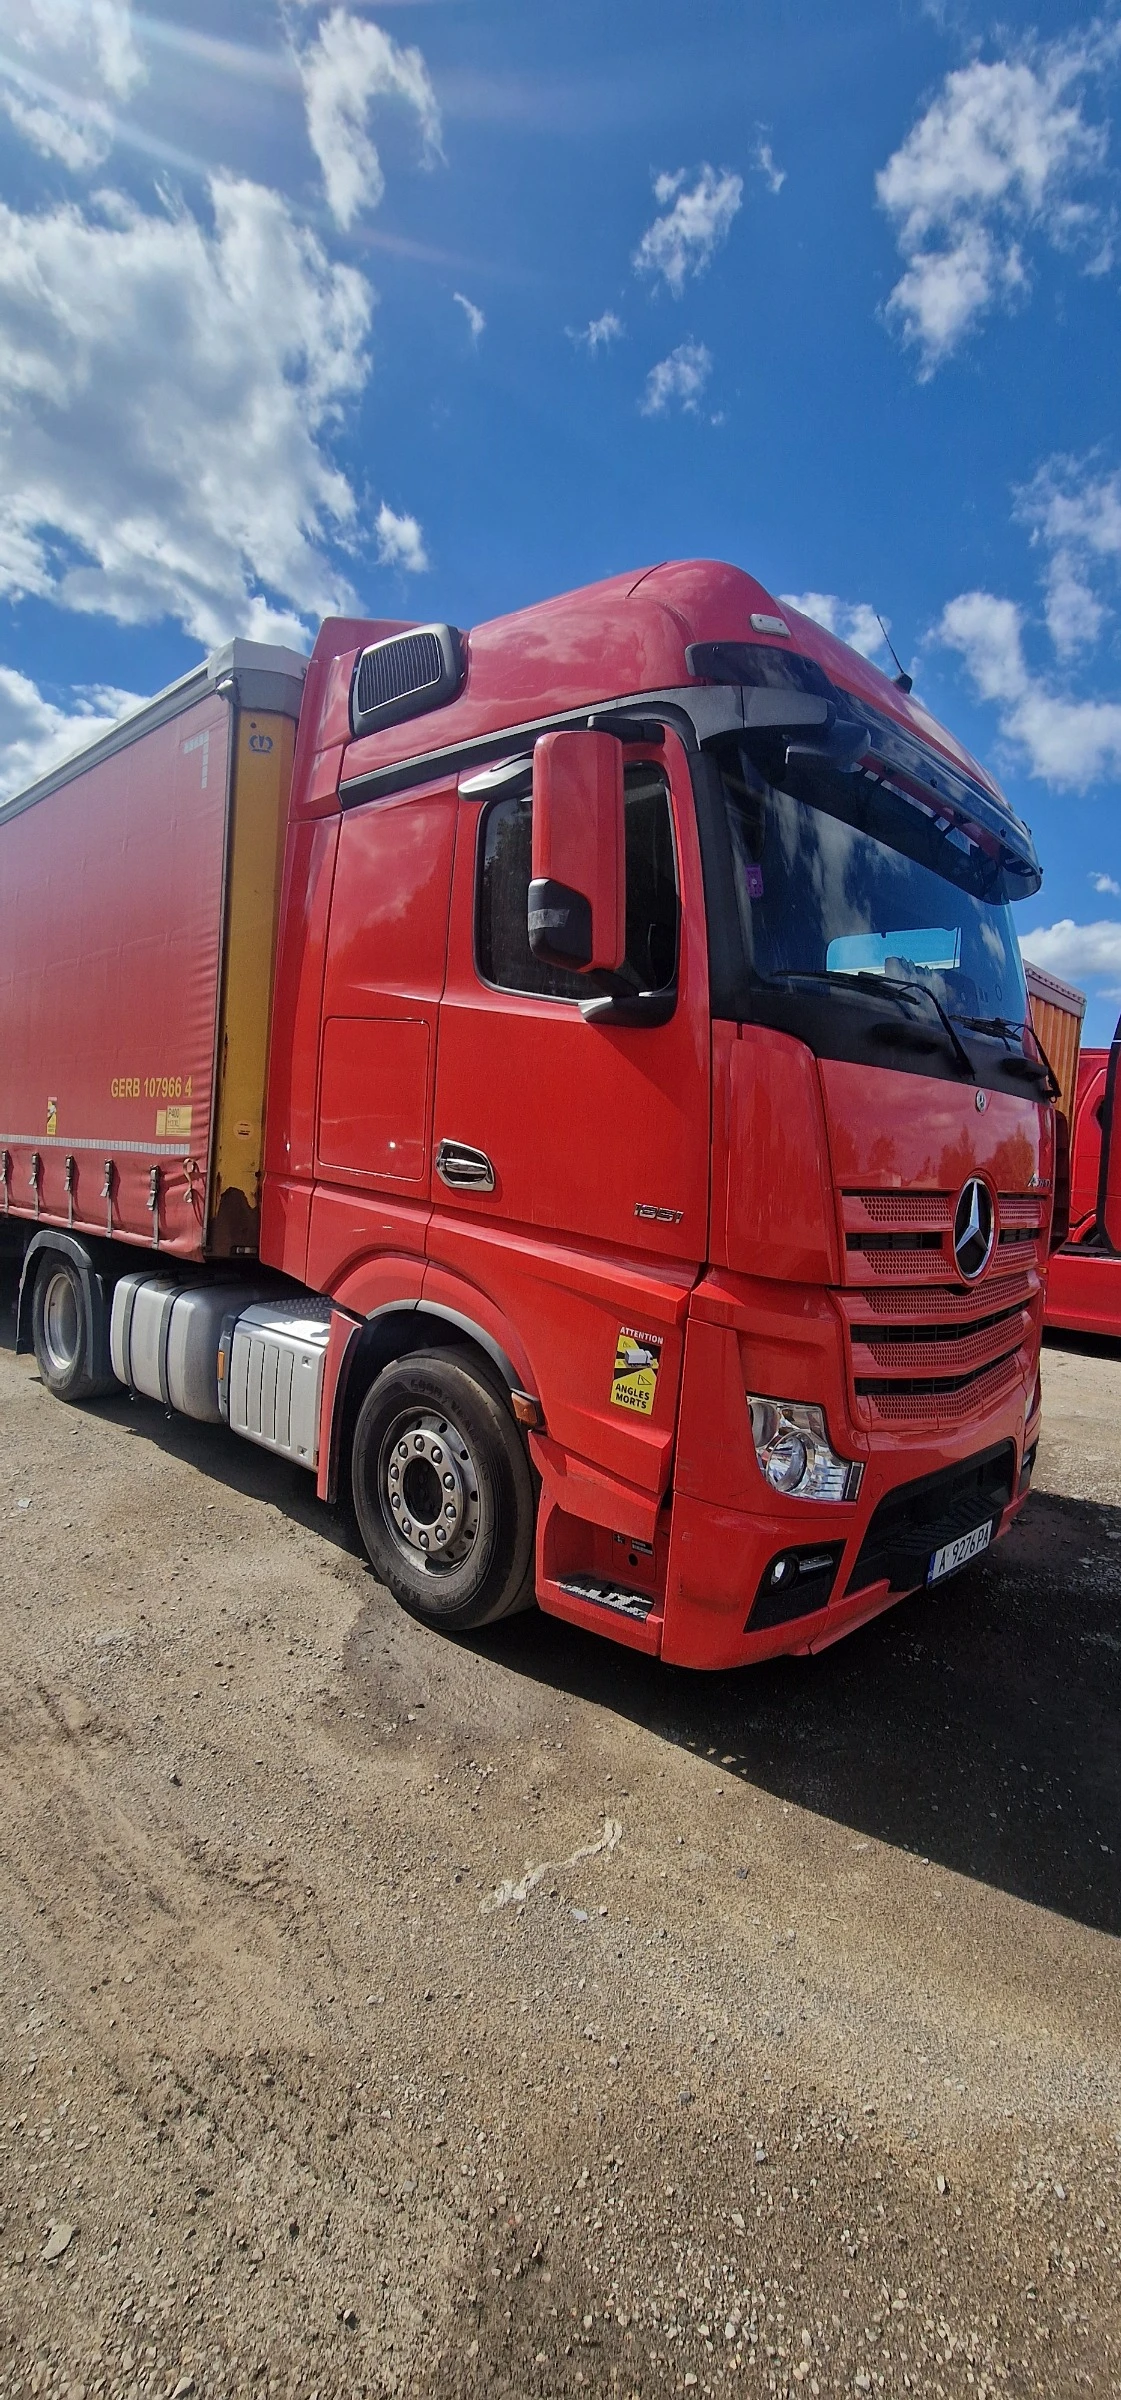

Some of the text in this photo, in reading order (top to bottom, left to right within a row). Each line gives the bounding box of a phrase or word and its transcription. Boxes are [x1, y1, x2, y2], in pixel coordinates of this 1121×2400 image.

[111, 1075, 192, 1098] GERB 107966 4
[620, 1326, 664, 1345] ATTENTION
[615, 1383, 650, 1401] ANGLES
[615, 1392, 647, 1409] MORTS
[938, 1549, 946, 1573] A
